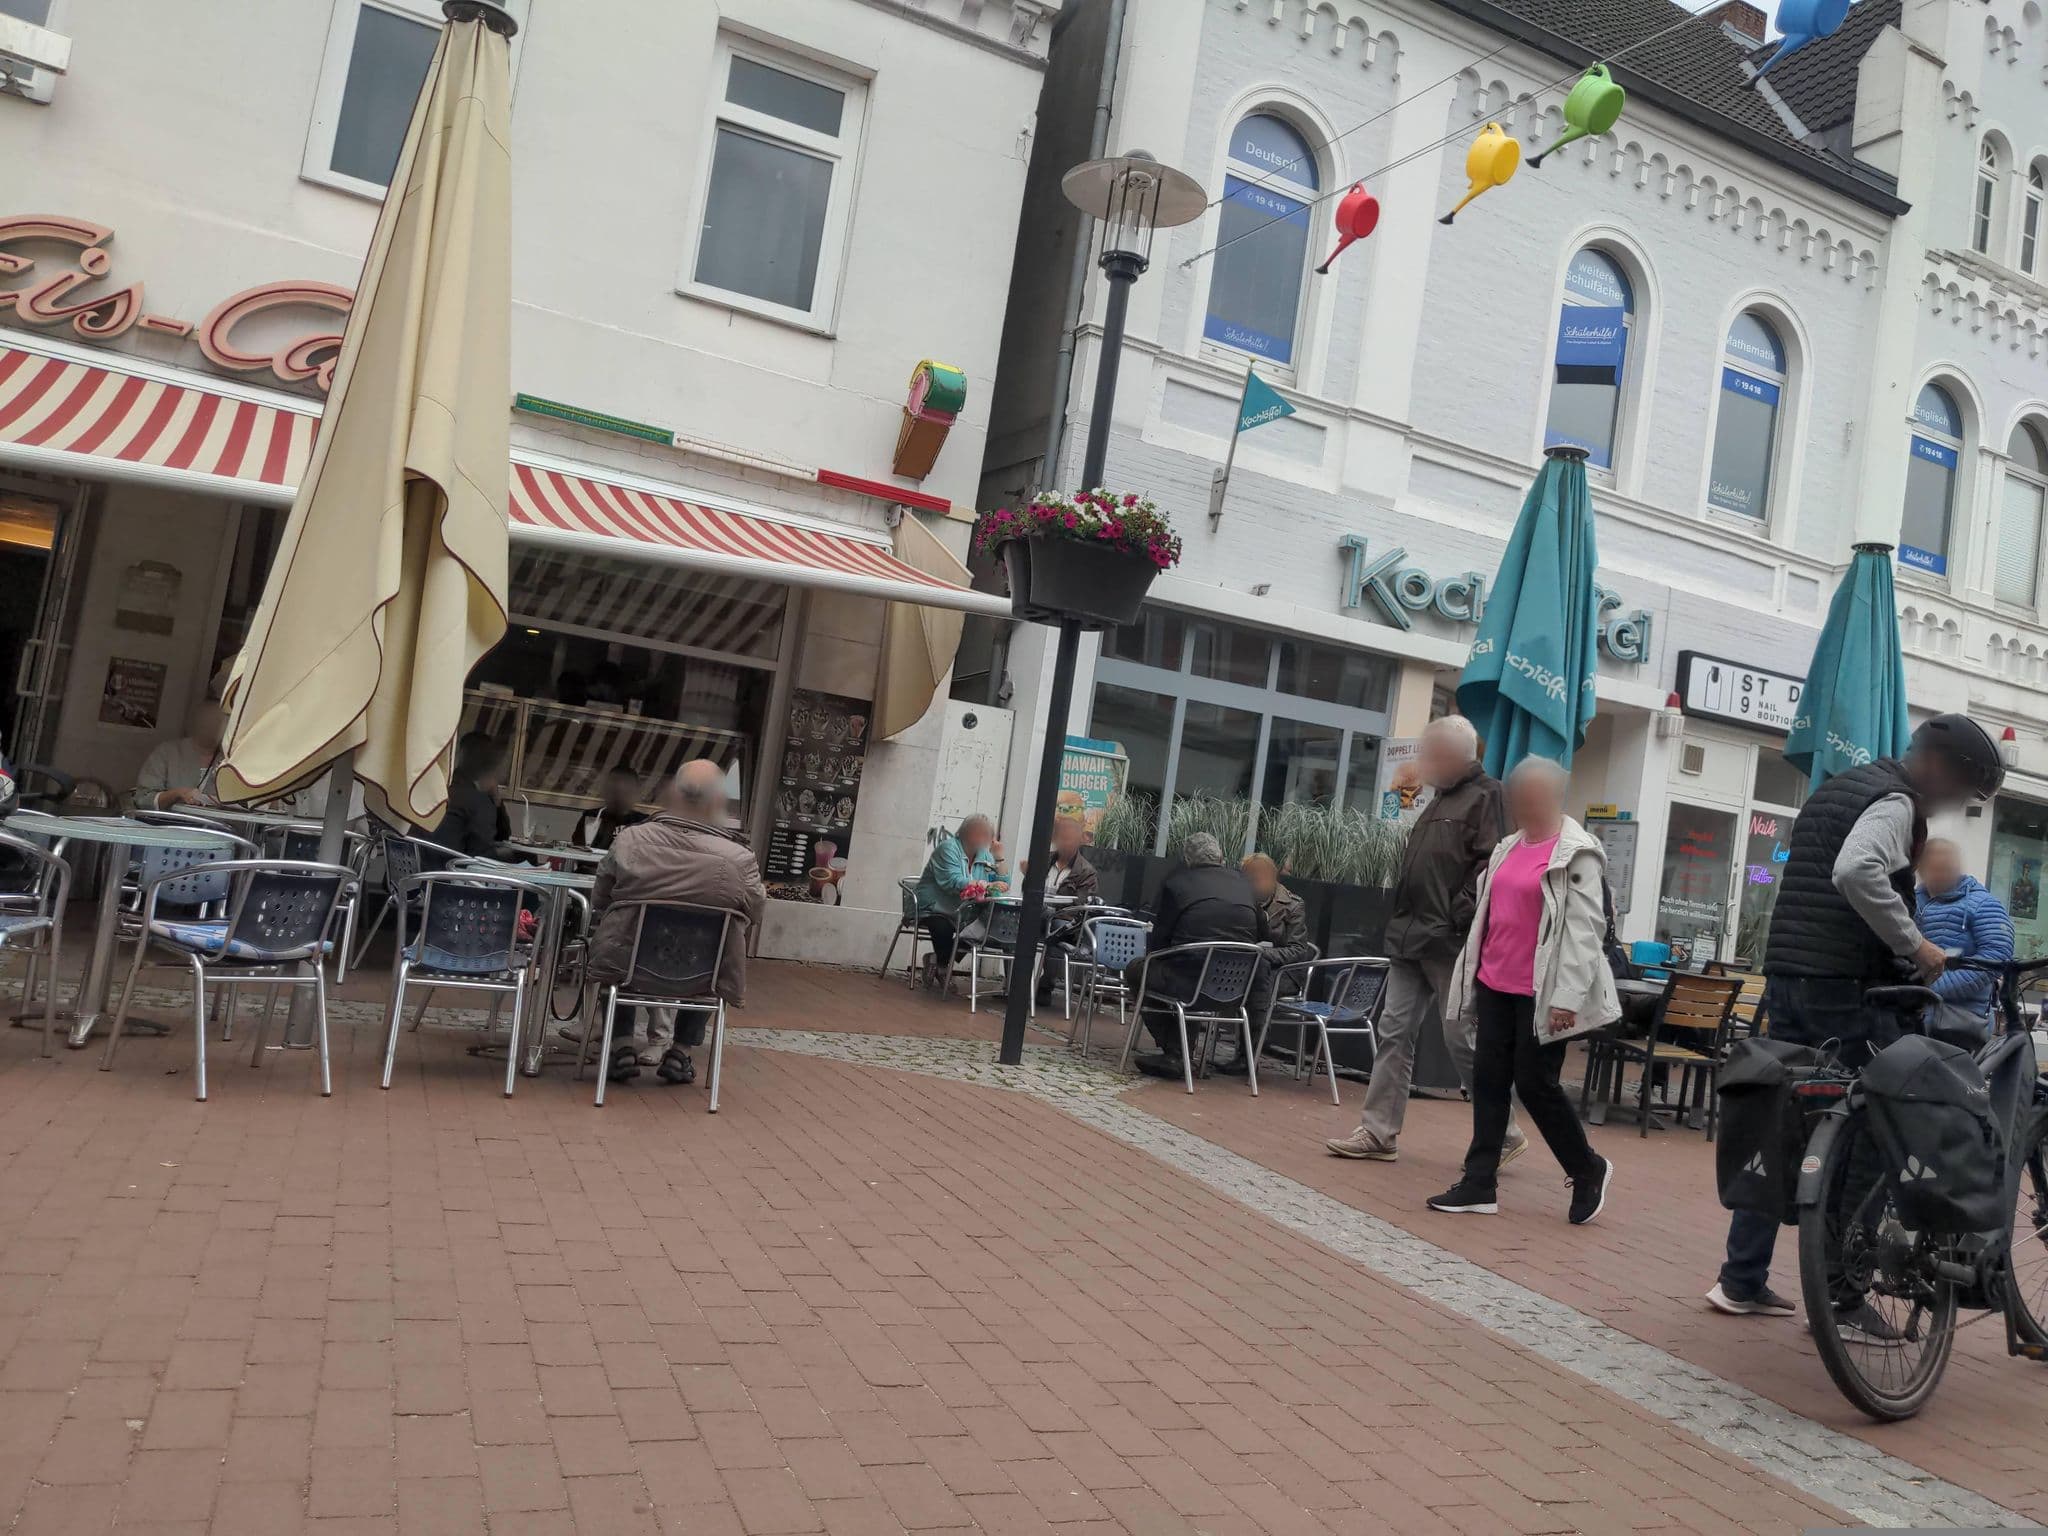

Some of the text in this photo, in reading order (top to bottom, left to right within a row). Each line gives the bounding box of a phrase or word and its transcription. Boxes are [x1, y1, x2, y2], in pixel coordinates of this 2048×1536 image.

[1245, 141, 1297, 172] Deutsch
[1915, 404, 1949, 427] Englisch
[1740, 696, 1750, 713] 9
[1758, 701, 1777, 712] NAIL
[1757, 711, 1794, 726] BOUTIQ
[1061, 772, 1108, 791] BURGER
[1750, 816, 1778, 837] Nails
